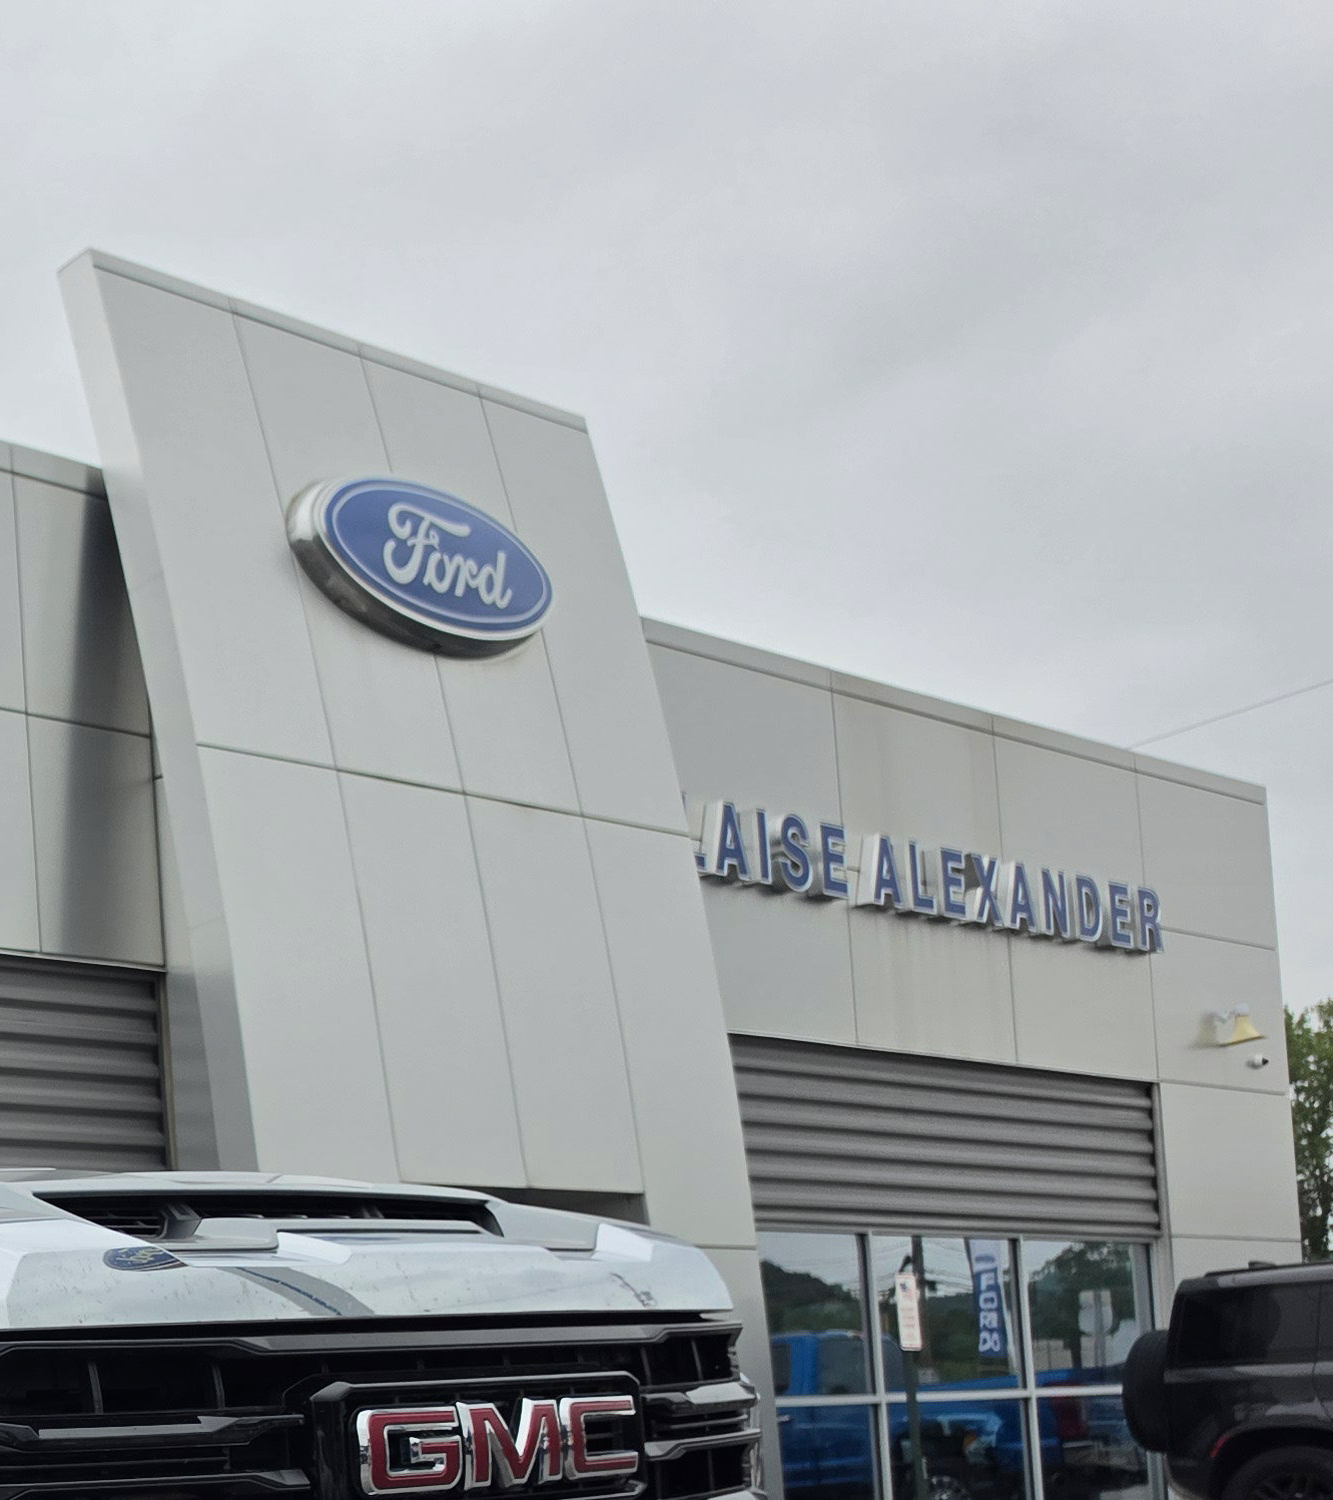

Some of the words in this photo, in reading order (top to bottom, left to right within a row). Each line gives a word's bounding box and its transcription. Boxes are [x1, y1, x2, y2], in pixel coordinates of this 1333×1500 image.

[382, 501, 513, 610] Ford
[694, 800, 849, 900] AISE
[867, 831, 1165, 954] ALEXANDER
[356, 1395, 638, 1496] GMC
